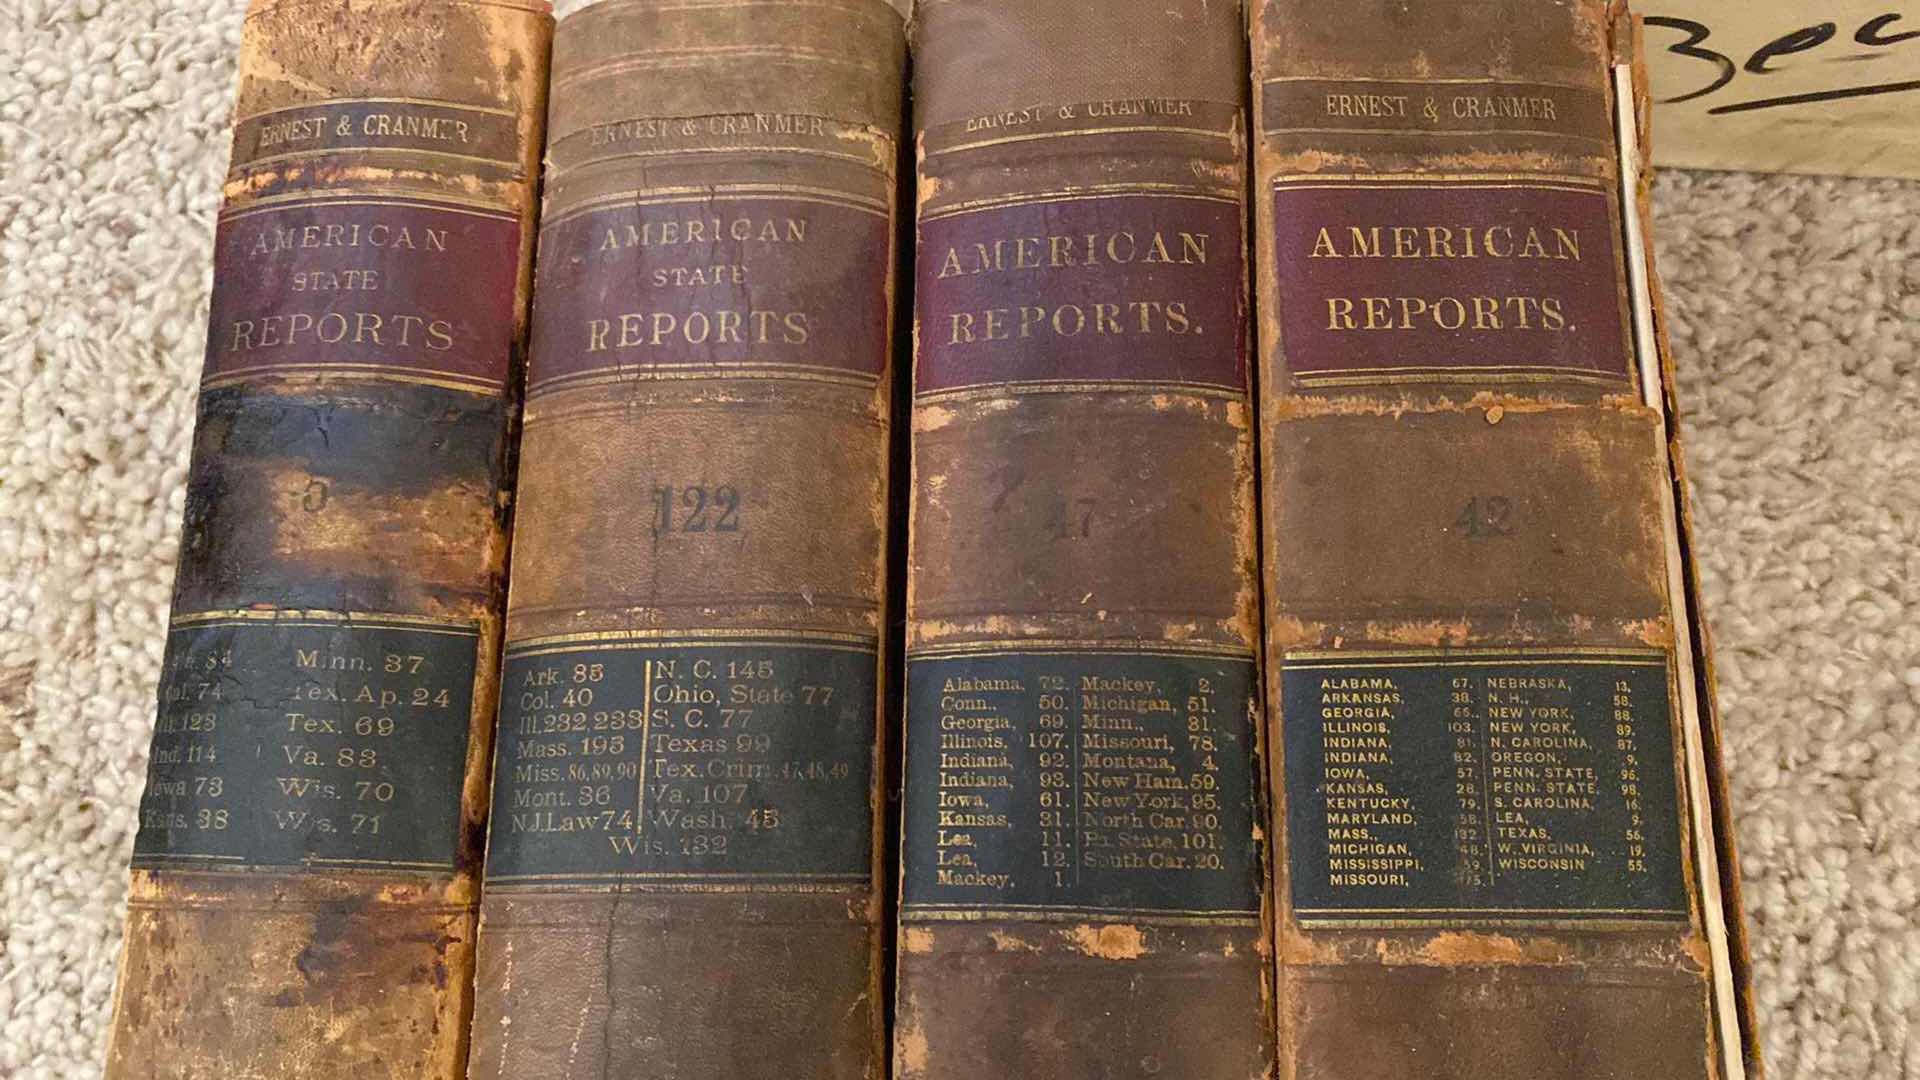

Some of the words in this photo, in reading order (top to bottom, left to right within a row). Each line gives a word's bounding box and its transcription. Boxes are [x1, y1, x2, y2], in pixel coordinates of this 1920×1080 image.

[1326, 95, 1408, 117] ERNEST
[1423, 97, 1440, 122] &
[1452, 96, 1556, 120] CRANMER
[261, 117, 327, 146] ERNEST
[336, 115, 352, 136] &
[681, 117, 697, 136] &
[709, 113, 824, 137] CRANMER
[250, 224, 449, 256] AMERICAN
[600, 219, 807, 250] AMERICAN
[1308, 226, 1582, 262] AMERICAN
[938, 231, 1208, 280] AMERICAN
[291, 270, 379, 292] STATE
[653, 265, 748, 287] STATE
[947, 302, 1203, 345] REPORTS.
[1326, 297, 1576, 330] REPORTS.
[232, 312, 454, 351] REPORTS
[586, 311, 810, 352] REPORTS
[653, 486, 738, 532] 122
[384, 654, 425, 674] 37
[655, 660, 683, 680] N.
[693, 659, 718, 680] C.
[522, 667, 564, 687] Ark.
[353, 685, 403, 709] Ap.
[411, 688, 449, 708] 24
[519, 691, 555, 711] Col.
[562, 687, 593, 708] 40
[654, 684, 721, 706] Ohio,
[730, 684, 793, 704] State
[802, 686, 834, 704] 77
[1081, 695, 1177, 716] Michigan,
[1187, 696, 1216, 713] 51.
[1489, 707, 1522, 719] NEW
[285, 713, 343, 735] Tex.
[355, 716, 395, 736] 69
[651, 709, 675, 728] S.
[684, 709, 708, 728] C.
[720, 709, 752, 728] 77
[941, 715, 1016, 732] Georgia,
[1490, 722, 1524, 733] NEW
[517, 739, 572, 760] Mass.
[651, 734, 728, 753] Texas
[1029, 733, 1069, 749] 107.
[1082, 733, 1175, 753] Missouri,
[1189, 735, 1218, 752] 78.
[1491, 737, 1506, 748] N.
[282, 745, 325, 766] Va.
[939, 753, 1014, 770] Indiana,
[1039, 752, 1070, 768] 92.
[1082, 752, 1176, 774] Montana,
[652, 759, 704, 779] Tex.
[1493, 767, 1540, 778] PENN.
[195, 776, 223, 797] 73
[939, 772, 1014, 789] Indiana,
[1082, 772, 1129, 788] New
[1136, 772, 1188, 789] Ham.
[1190, 774, 1220, 790] 59.
[355, 781, 394, 802] 70
[513, 789, 572, 808] Mont.
[650, 784, 690, 803] Va.
[703, 784, 748, 803] 107
[938, 792, 989, 808] Iowa,
[1040, 792, 1070, 808] 61.
[1083, 791, 1129, 808] New
[1192, 794, 1221, 810] 95.
[1494, 797, 1508, 808] S.
[351, 814, 381, 834] 71
[649, 808, 733, 830] Wash.
[608, 835, 669, 855] Wis.
[680, 835, 727, 855] 132
[1041, 831, 1071, 848] 11.
[1182, 833, 1224, 850] 101.
[1041, 850, 1070, 868] 12.
[1149, 852, 1191, 869] Car.
[1329, 859, 1424, 872] MISSISSIPPI,
[1498, 858, 1585, 871] WISCONSIN
